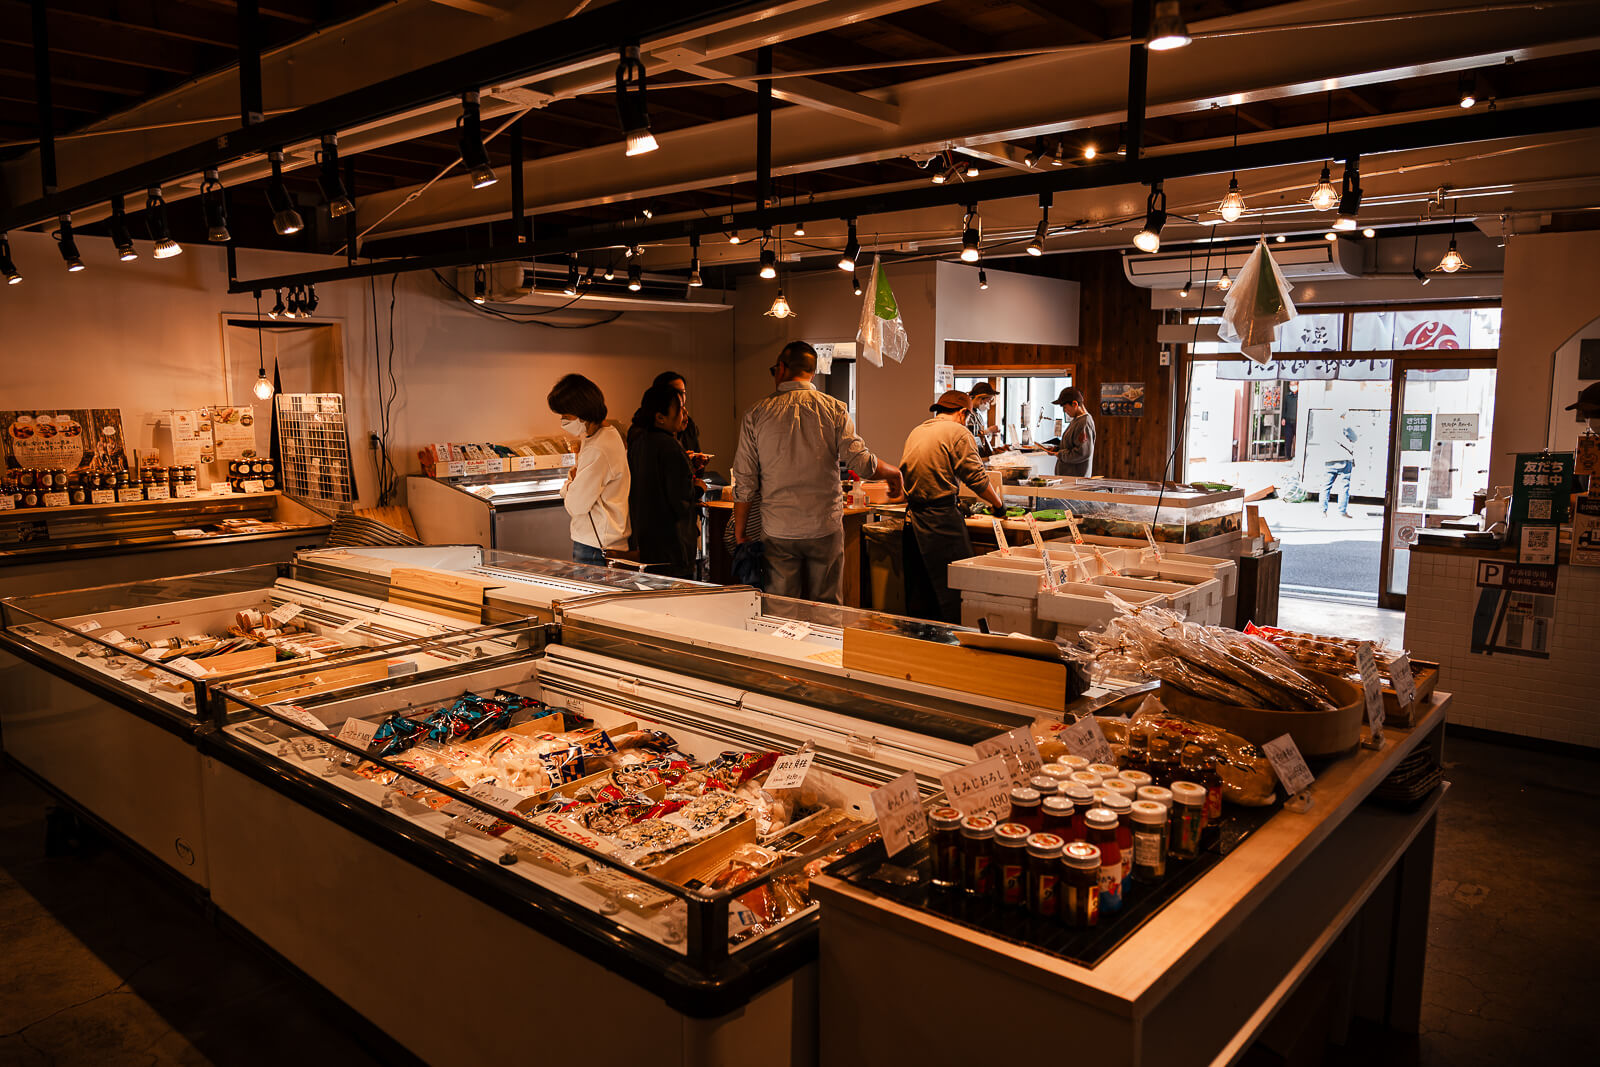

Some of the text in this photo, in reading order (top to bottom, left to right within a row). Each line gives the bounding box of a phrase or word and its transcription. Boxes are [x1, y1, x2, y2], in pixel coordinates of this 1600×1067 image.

[1523, 460, 1564, 473] 友だち
[1522, 474, 1563, 486] 募集中
[1484, 564, 1500, 582] P
[953, 769, 1005, 796] もみじおろし
[989, 792, 1009, 808] 490
